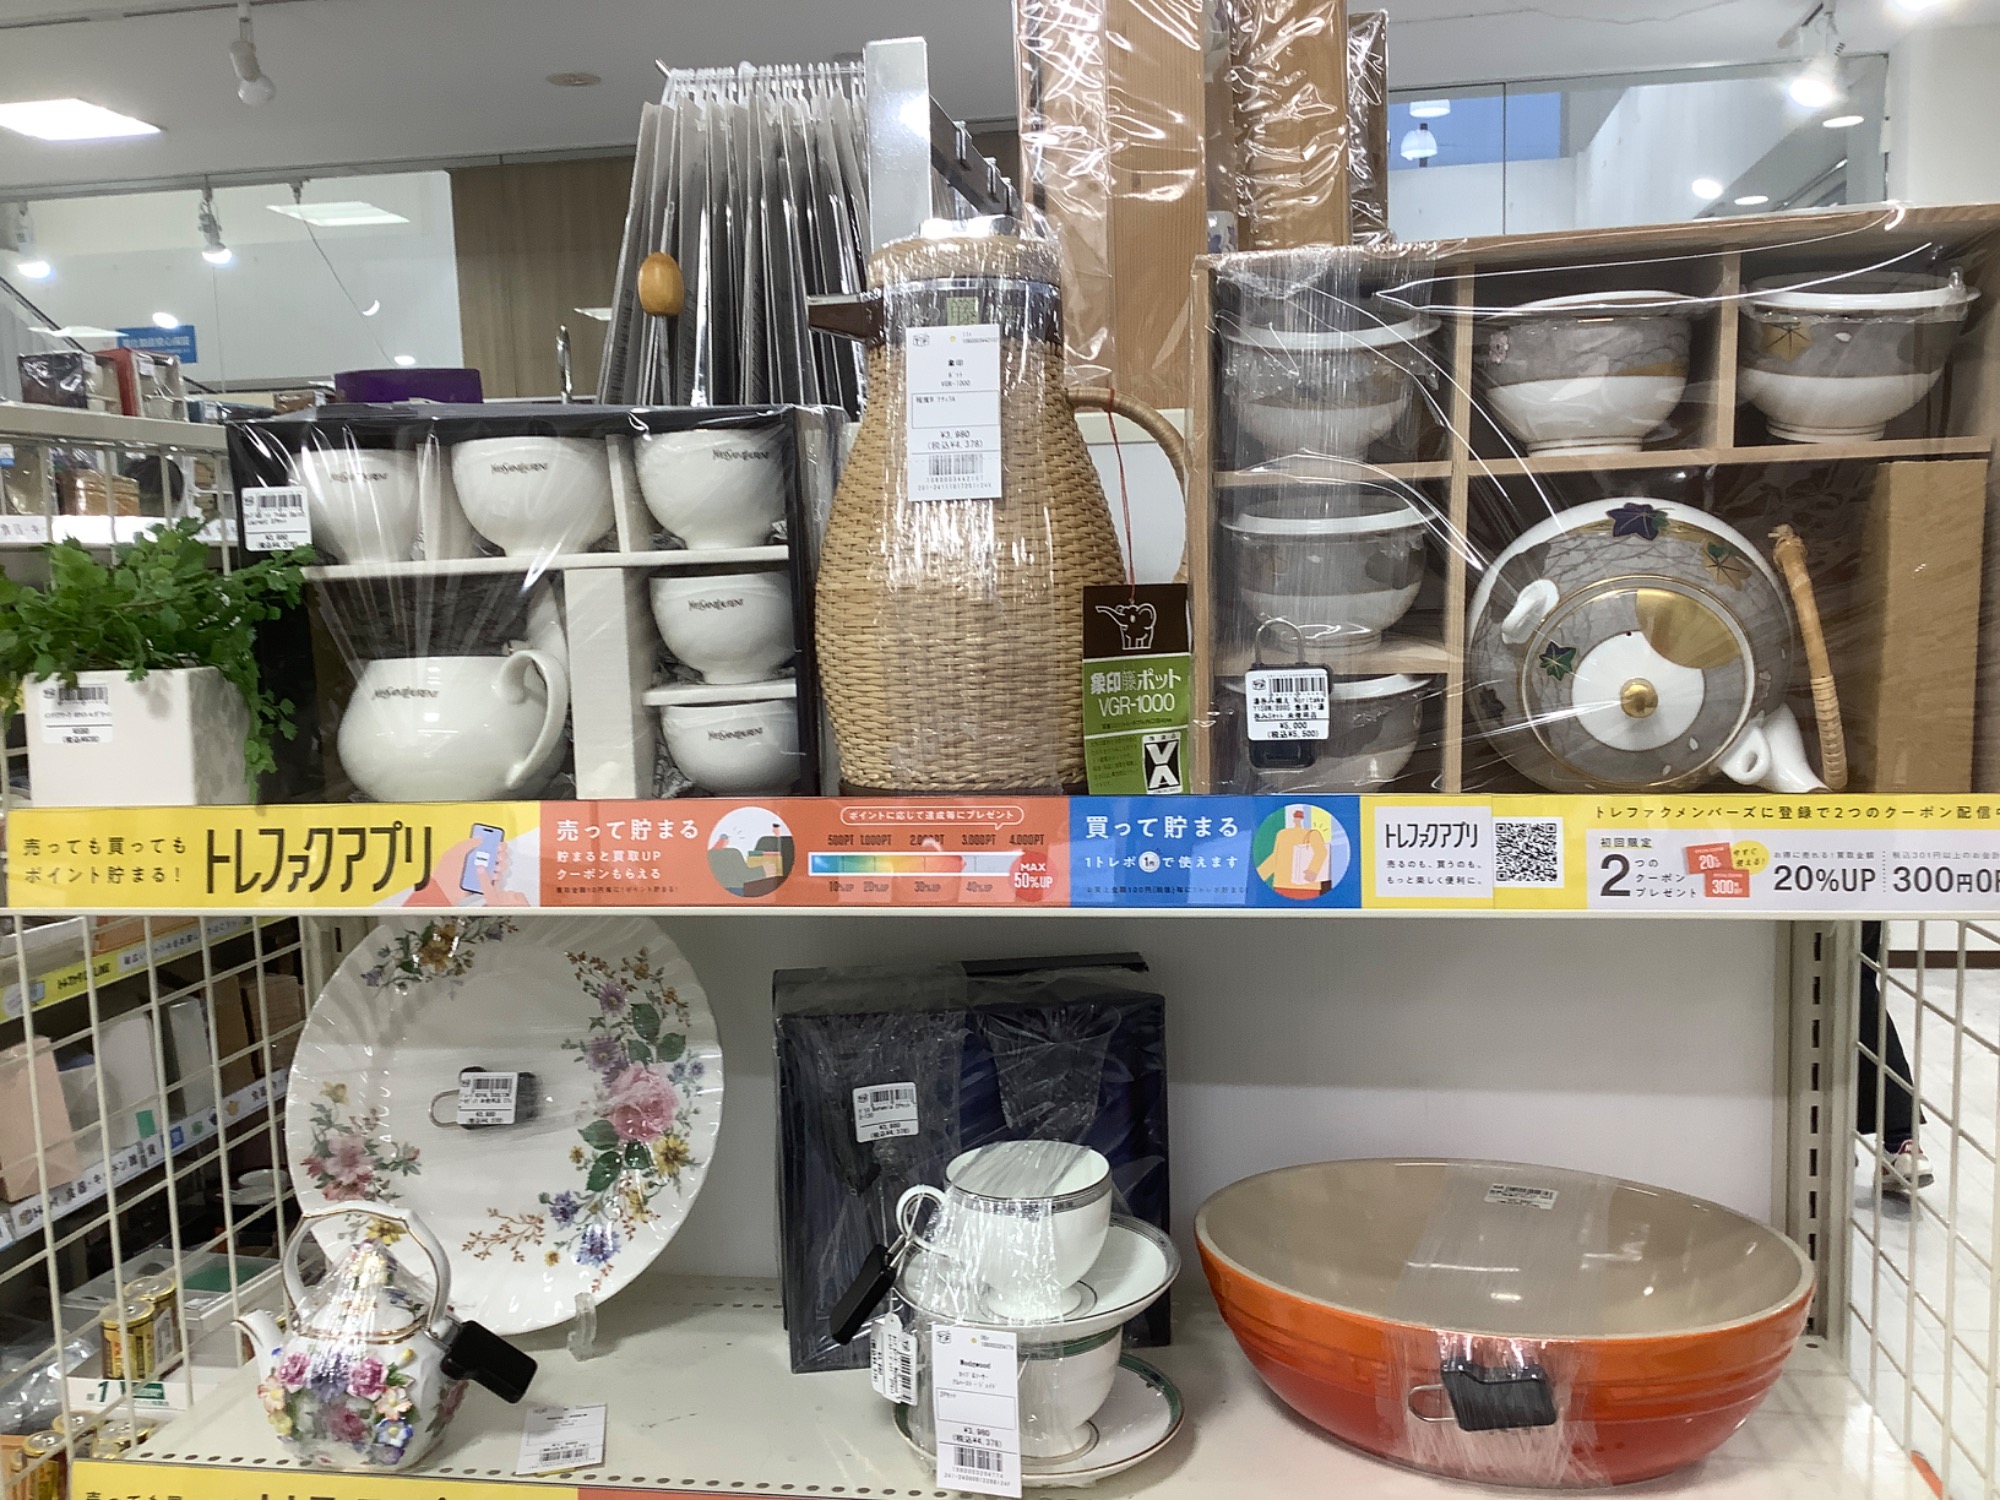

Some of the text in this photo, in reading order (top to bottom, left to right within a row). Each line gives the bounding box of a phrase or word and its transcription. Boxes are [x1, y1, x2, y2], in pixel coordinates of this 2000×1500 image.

[1098, 693, 1175, 717] VGR-1000
[556, 819, 699, 842] 売って貯まる
[1085, 816, 1239, 839] 買って貯まる
[828, 834, 854, 846] 500PT
[1385, 821, 1478, 848] トレファクアプリ
[23, 837, 186, 855] 売っても買っても
[1600, 837, 1652, 848] 初回限定
[206, 818, 432, 894] トレファクアプリ
[556, 850, 662, 863] 貯まると買取UP
[1020, 863, 1046, 872] MAX
[1387, 859, 1483, 869] 売るのも、買うのも。
[1635, 858, 1658, 868] つの
[556, 868, 661, 880] クーポンもらえる
[1014, 872, 1053, 889] 50%UP
[1387, 875, 1483, 885] もっと楽しく便利に。
[1600, 853, 1631, 897] 2
[1635, 873, 1685, 883] クーポン
[1774, 865, 1876, 892] 20%UP
[1636, 887, 1697, 898] プレゼント
